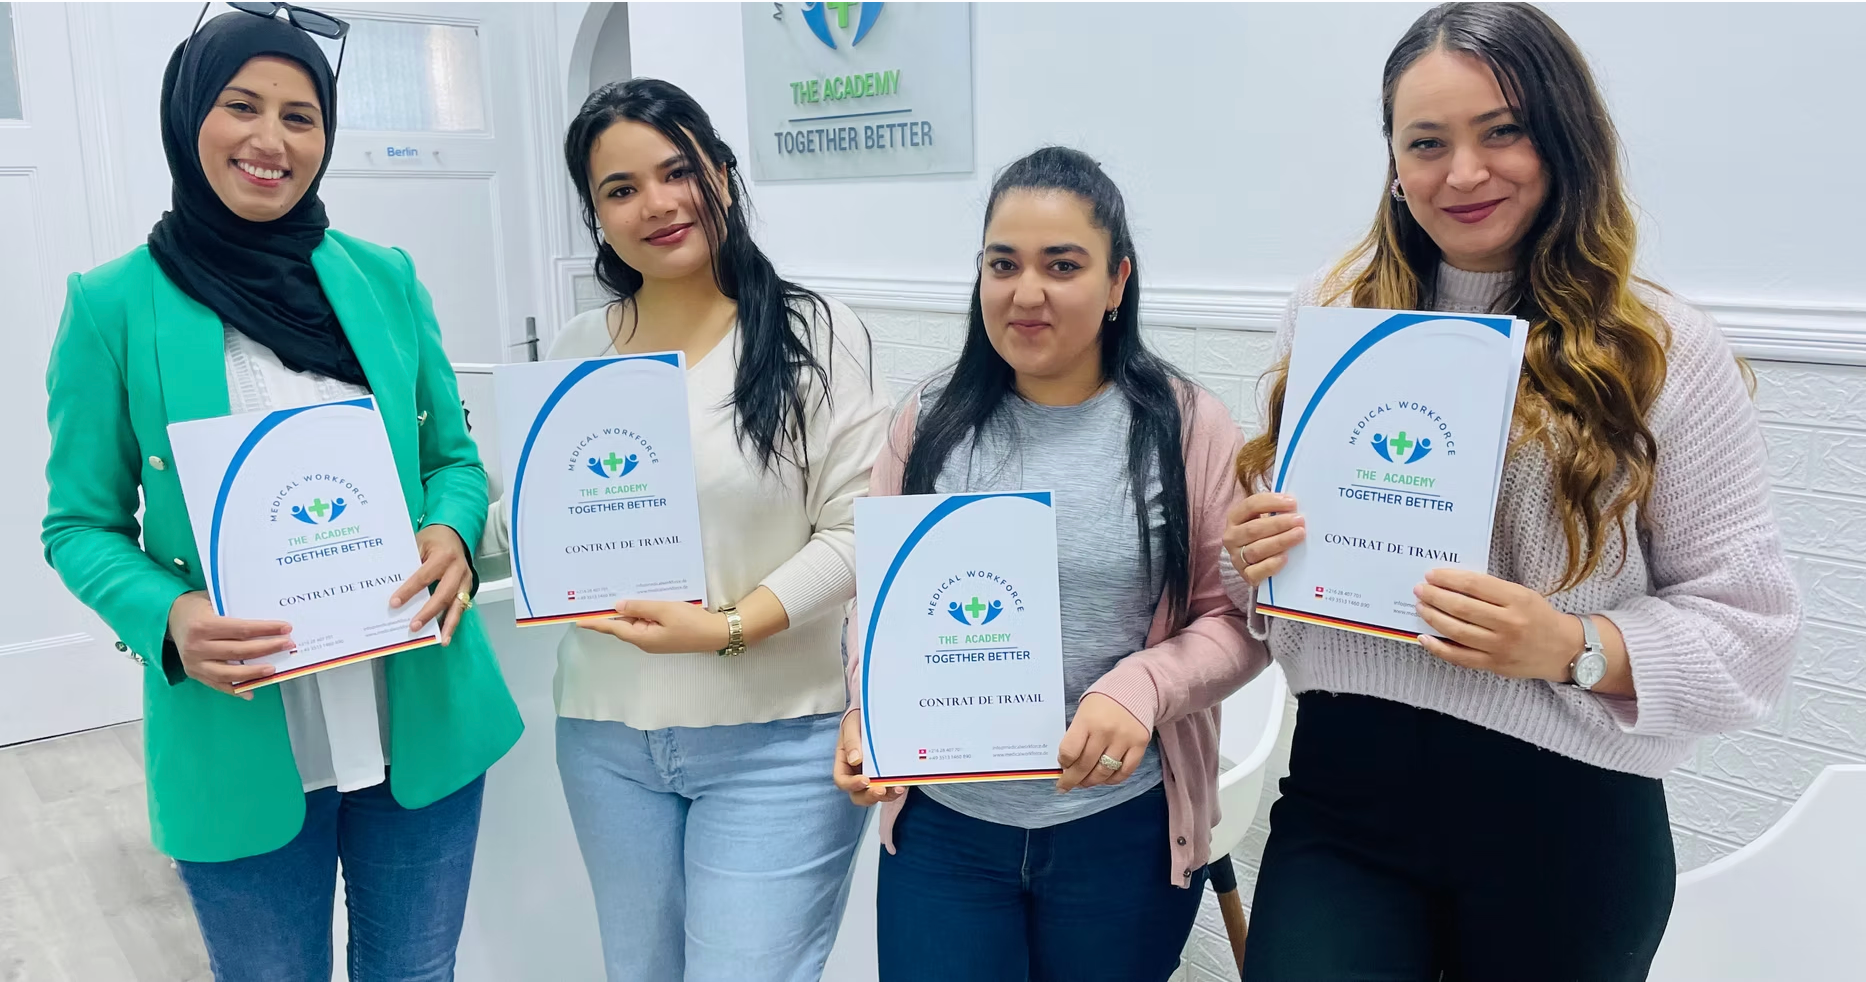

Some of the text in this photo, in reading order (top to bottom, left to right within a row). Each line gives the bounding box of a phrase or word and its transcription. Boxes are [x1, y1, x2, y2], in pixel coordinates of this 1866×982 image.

[790, 70, 900, 105] THE ACADEMY
[774, 121, 932, 155] TOGETHER BETTER
[387, 147, 418, 157] Berlin
[1349, 401, 1455, 456] MEDICAL WORKFORCE
[568, 428, 659, 471] MEDICAL WORKFORCE
[580, 484, 647, 497] THE ACADEMY
[1356, 469, 1436, 488] THE ACADEMY
[270, 474, 368, 522] MEDICAL WORKFORCE
[568, 498, 666, 514] TOGETHER BETTER
[1338, 487, 1453, 512] TOGETHER BETTER
[288, 525, 359, 547] THE ACADEMY
[565, 536, 681, 554] CONTRAT DE TRAVAIL
[1325, 534, 1460, 563] CONTRAT DE TRAVAIL
[276, 538, 383, 566] TOGETHER BETTER
[279, 574, 404, 606] CONTRAT DE TRAVAIL
[928, 570, 1024, 615] MEDICAL WORKFORCE
[938, 634, 1011, 644] THE ACADEMY
[925, 651, 1030, 664] TOGETHER BETTER
[919, 694, 1044, 707] CONTRAT DE TRAVAIL
